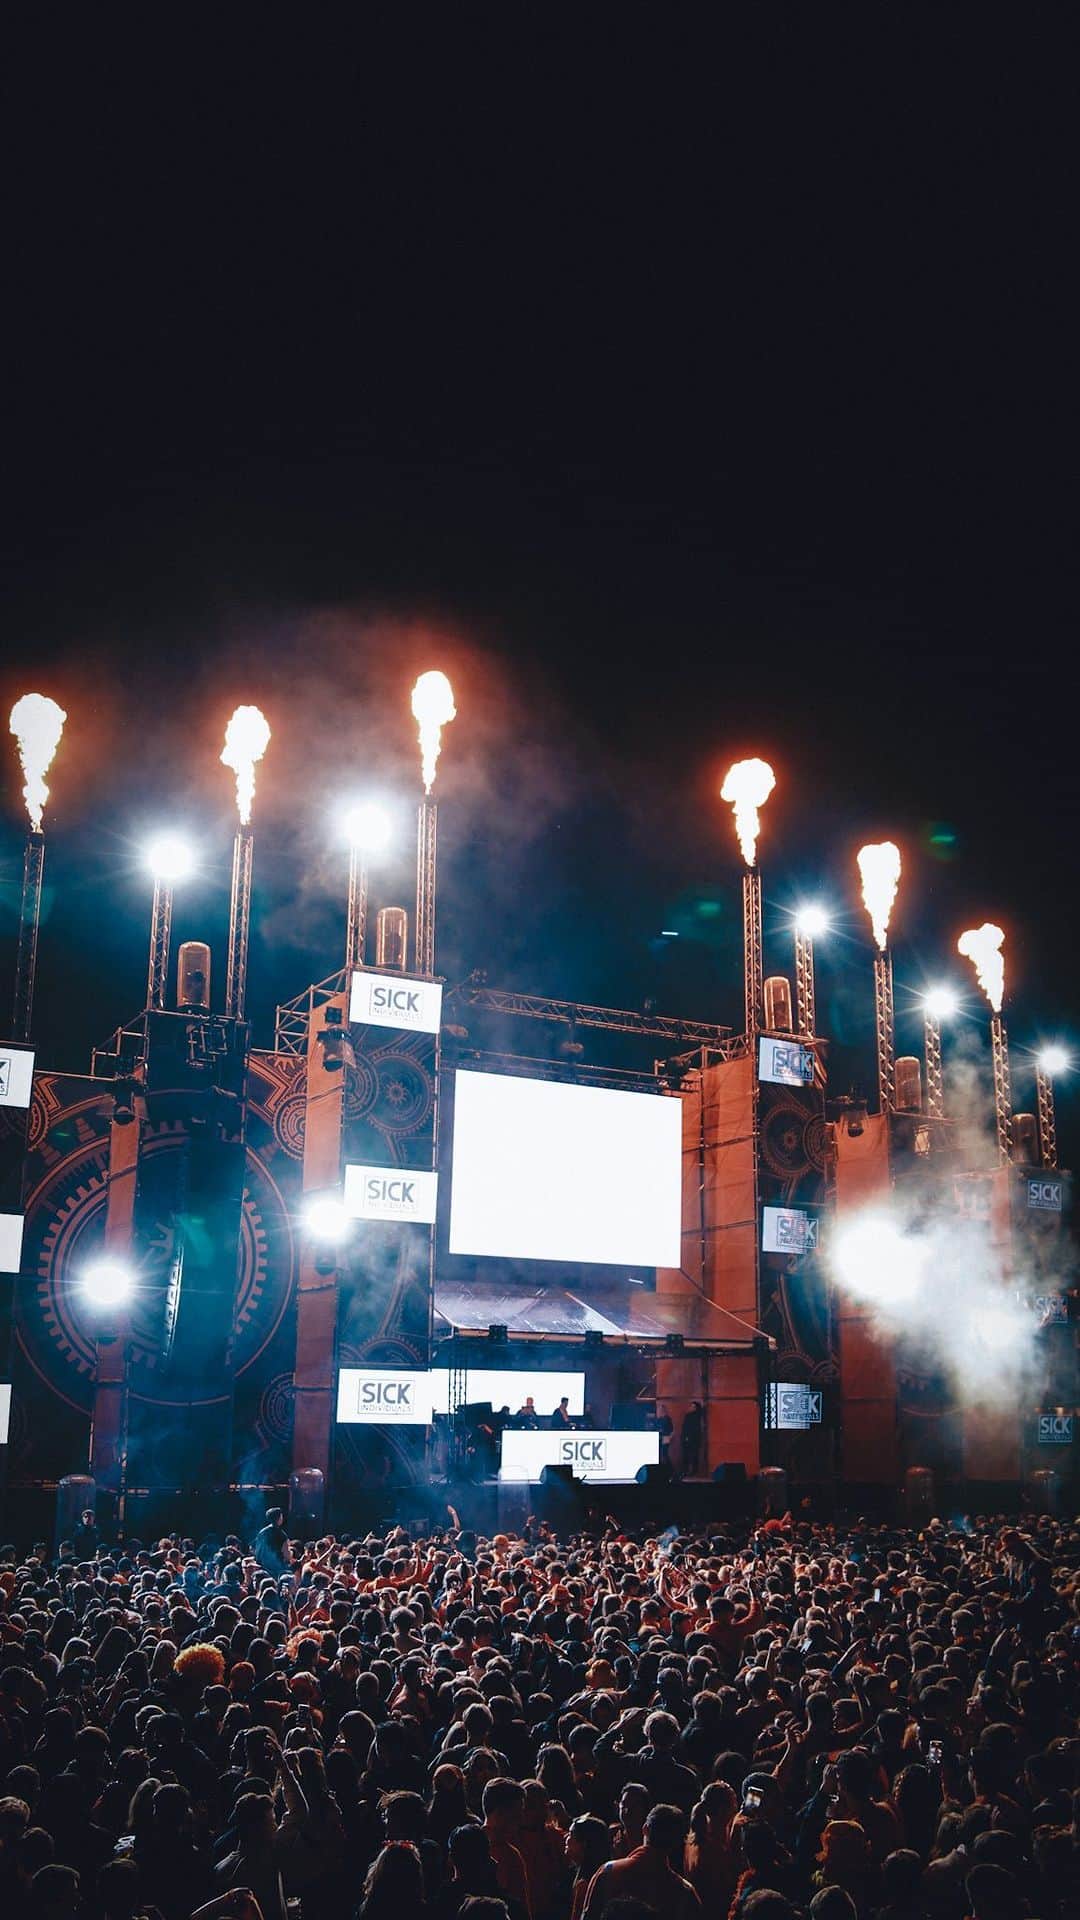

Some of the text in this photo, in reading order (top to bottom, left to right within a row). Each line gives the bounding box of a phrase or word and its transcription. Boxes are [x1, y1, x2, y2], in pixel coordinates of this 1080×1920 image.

[374, 988, 419, 1012] SICK
[368, 1180, 414, 1203] SICK
[1031, 1183, 1059, 1201] SICK
[362, 1383, 411, 1404] SICK
[1041, 1417, 1070, 1434] SICK
[562, 1441, 603, 1461] SICK
